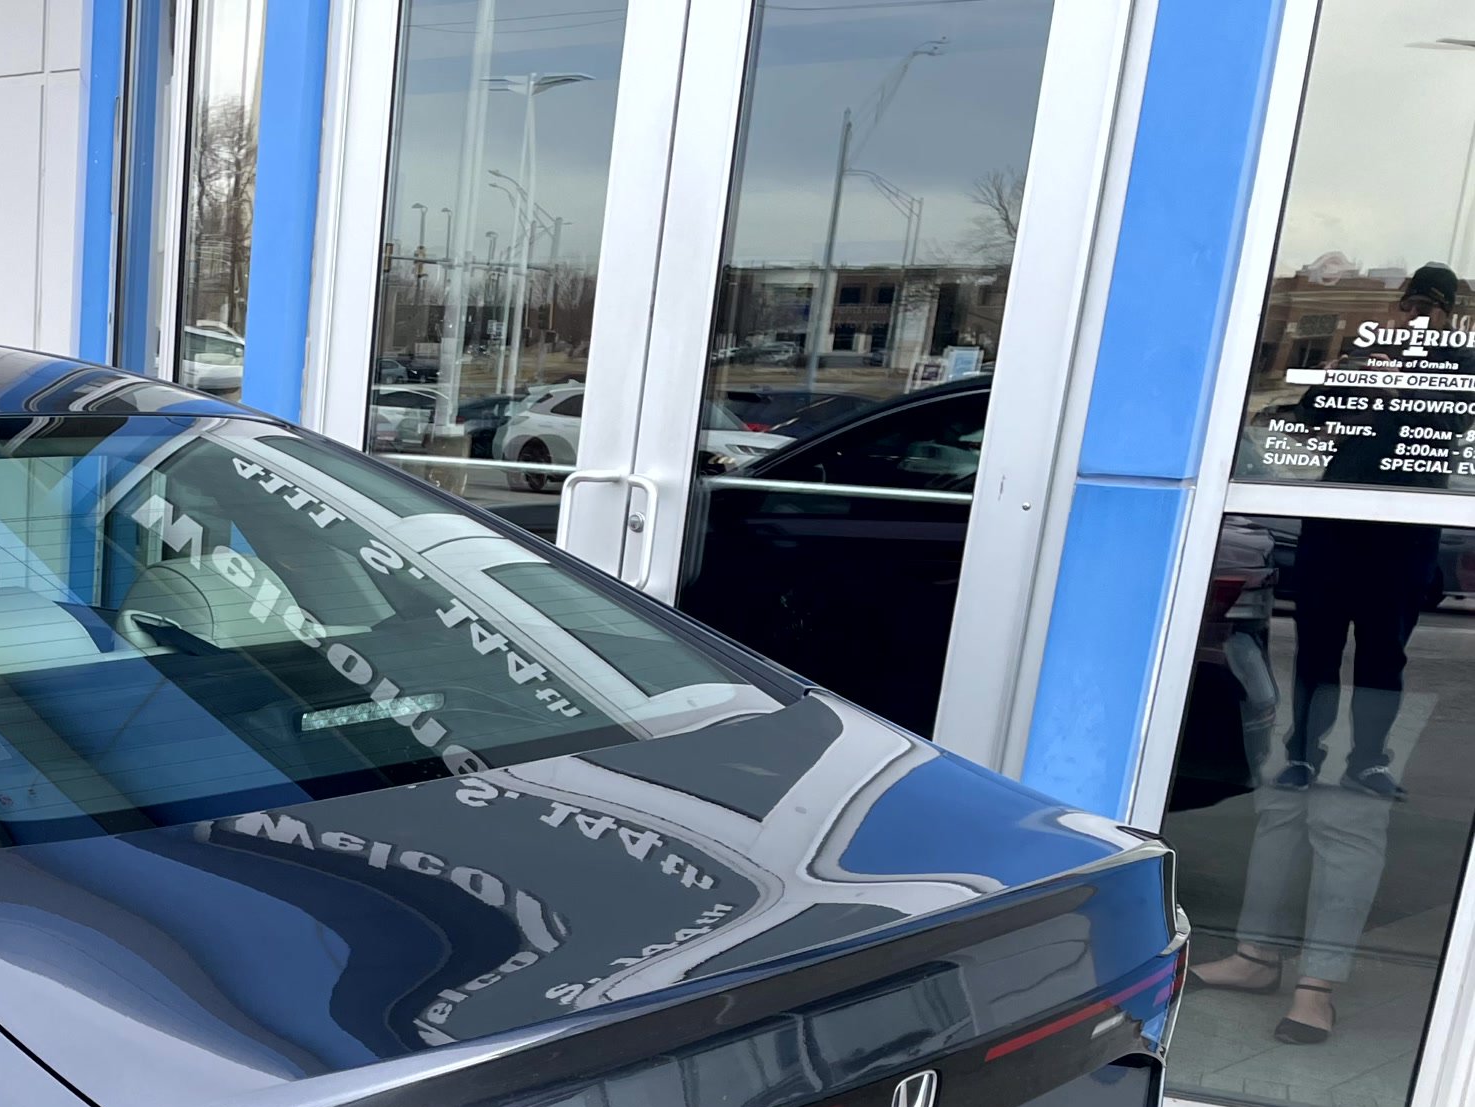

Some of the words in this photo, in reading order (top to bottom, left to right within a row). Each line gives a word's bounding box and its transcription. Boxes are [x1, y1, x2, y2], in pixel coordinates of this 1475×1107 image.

[1367, 359, 1403, 369] Honda
[1405, 360, 1418, 368] of
[1419, 360, 1459, 370] Omaha
[1324, 371, 1378, 385] HOURS
[1382, 375, 1403, 385] OF
[1406, 375, 1475, 388] OPERATI
[1313, 395, 1369, 410] SALES
[1373, 398, 1384, 411] &
[1268, 419, 1309, 434] Mon.
[1325, 421, 1377, 436] Thurs.
[1399, 425, 1453, 440] 8:00AM
[1265, 436, 1290, 450] Fri.
[1306, 438, 1338, 452] Sat.
[1395, 443, 1449, 458] 8:00AM
[1263, 452, 1334, 467] SUNDAY
[1379, 457, 1453, 474] SPECIAL
